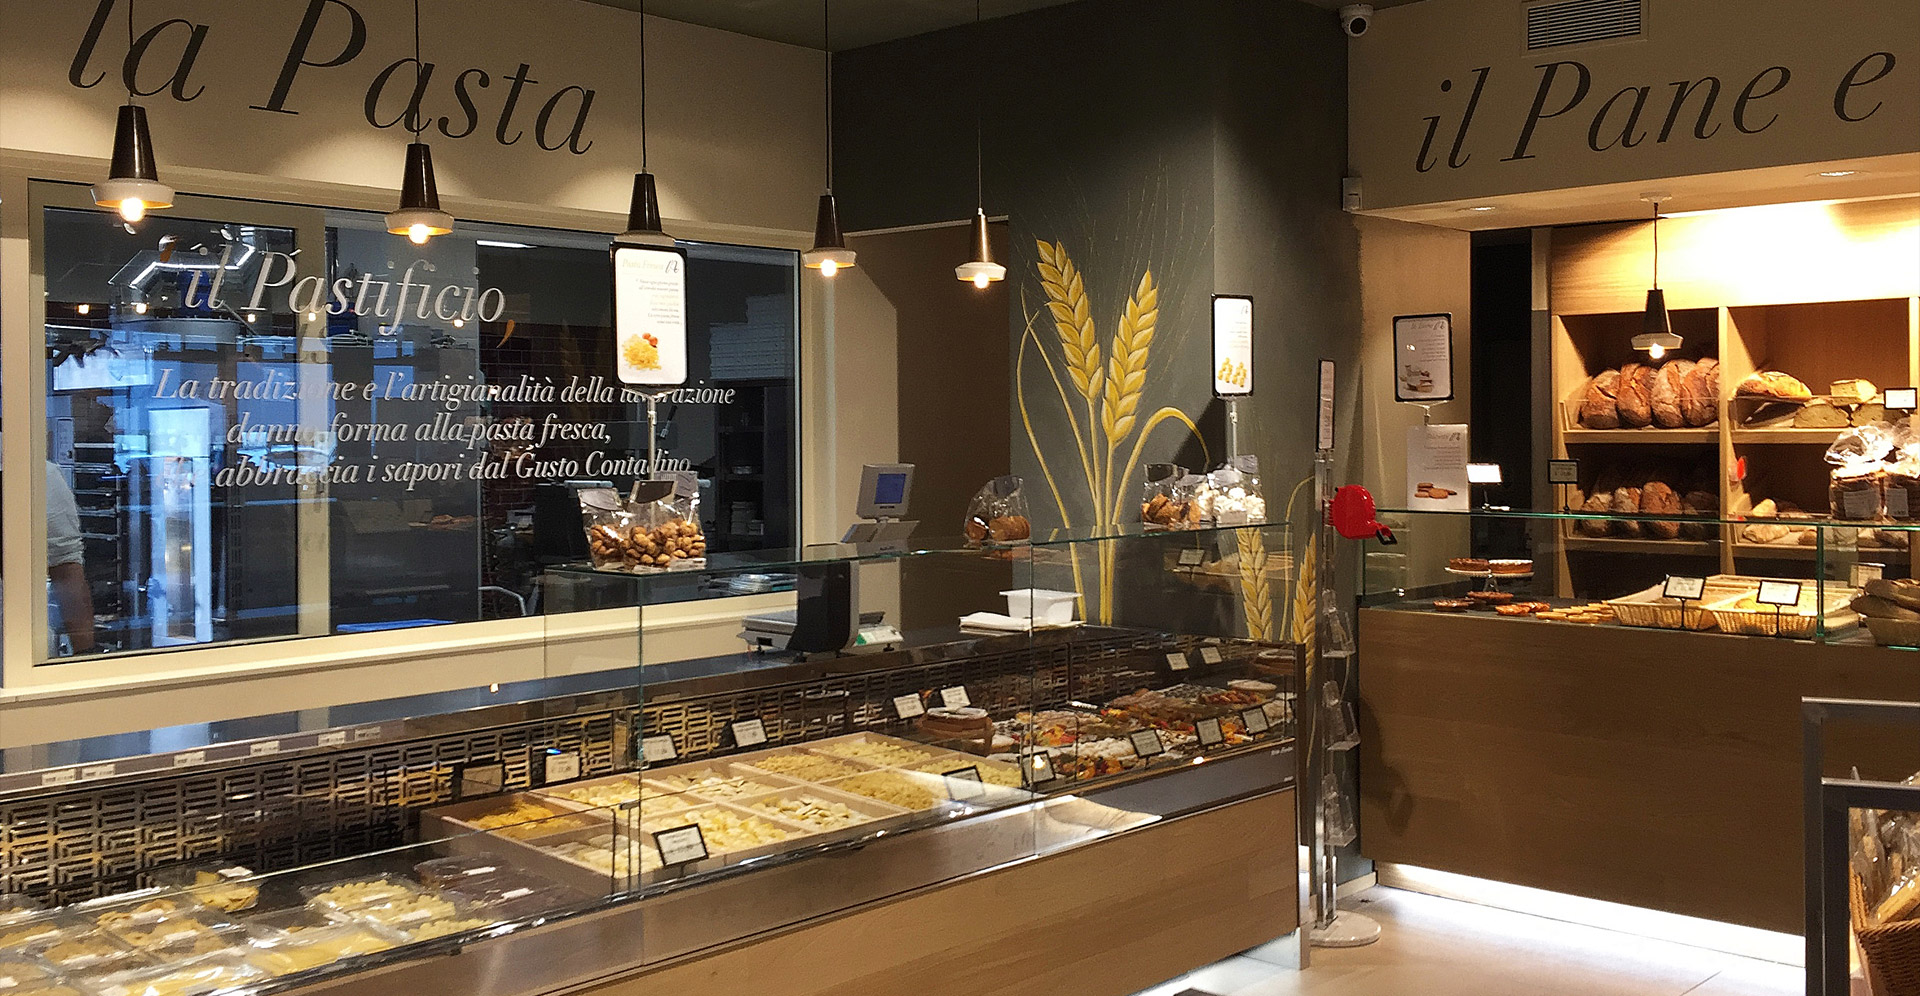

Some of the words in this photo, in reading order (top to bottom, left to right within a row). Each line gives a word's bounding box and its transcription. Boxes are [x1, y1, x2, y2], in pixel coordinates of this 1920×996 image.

[68, 0, 209, 102] la
[249, 0, 596, 155] Pasta
[1415, 67, 1491, 173] il
[1500, 60, 1791, 163] Pane
[1833, 51, 1896, 122] e
[184, 244, 232, 309] il
[154, 368, 200, 400] La
[362, 380, 377, 401] e
[560, 375, 613, 404] della
[326, 412, 408, 449] forma
[414, 412, 464, 443] alla
[467, 417, 534, 449] pasta
[536, 413, 612, 448] fresca,
[366, 454, 378, 483] i
[381, 453, 463, 491] sapori
[468, 451, 509, 480] dal
[516, 453, 579, 478] Gusto
